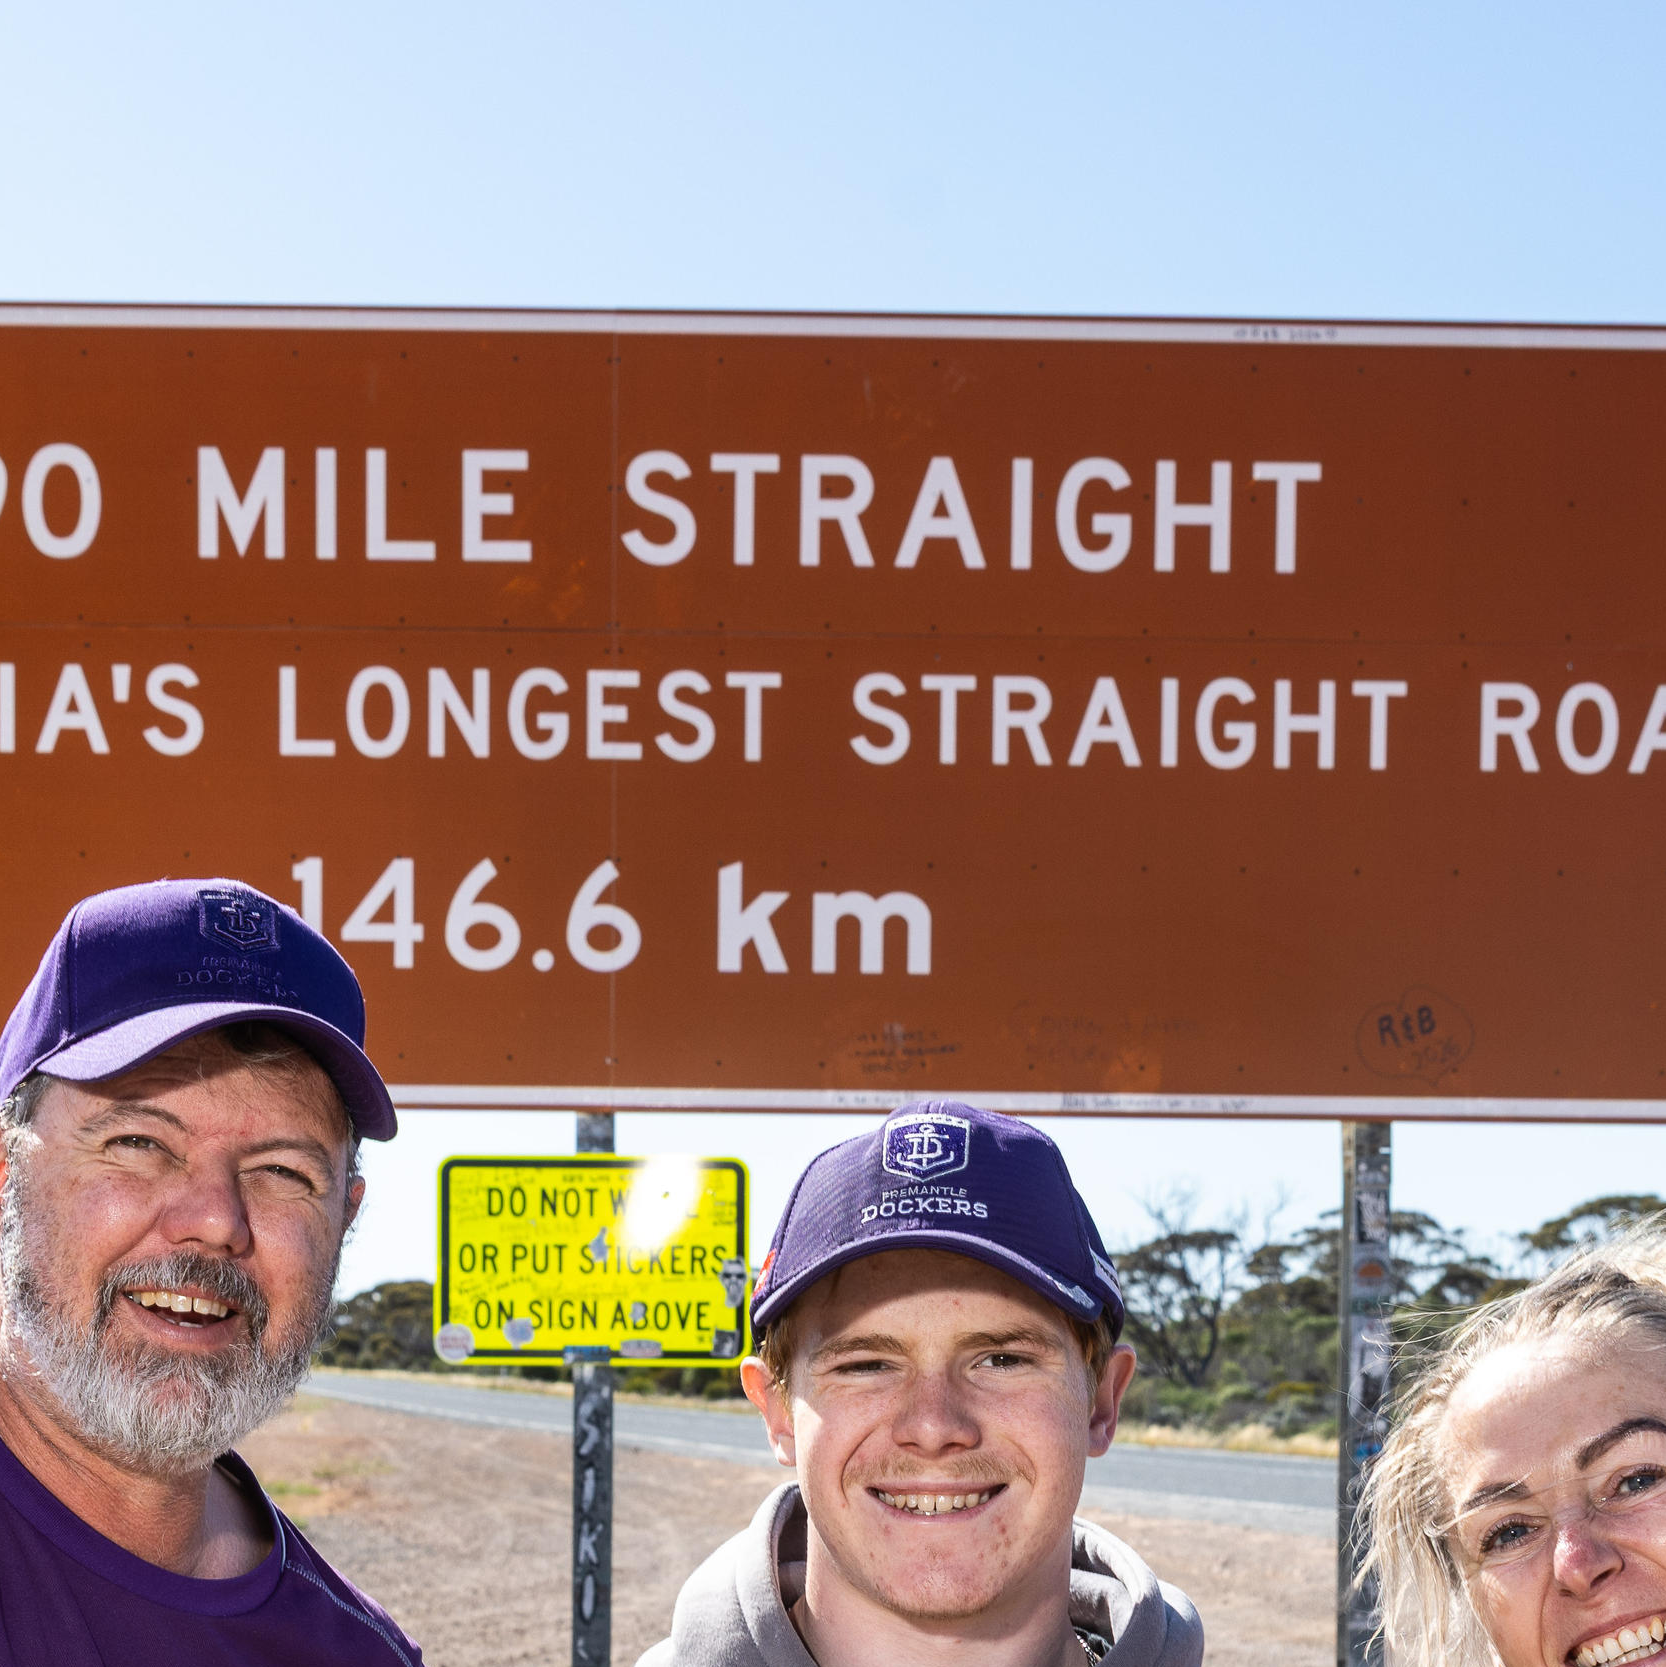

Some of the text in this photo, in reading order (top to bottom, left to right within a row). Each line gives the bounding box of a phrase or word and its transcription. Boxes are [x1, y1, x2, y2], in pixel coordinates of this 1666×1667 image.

[197, 446, 532, 562] MILE
[621, 450, 1322, 574] STRAIGHT
[279, 666, 782, 762] LONGEST
[850, 672, 1408, 770] STRAIGHT
[291, 856, 932, 975] 146.6 km
[487, 1187, 527, 1217] DO
[541, 1187, 598, 1217] NOT
[882, 1185, 967, 1202] FREMANTLE
[861, 1198, 988, 1224] DOCKERS
[459, 1243, 499, 1274] OR
[511, 1244, 569, 1274] PUT
[474, 1300, 514, 1330] ON
[529, 1300, 598, 1331] SIGN
